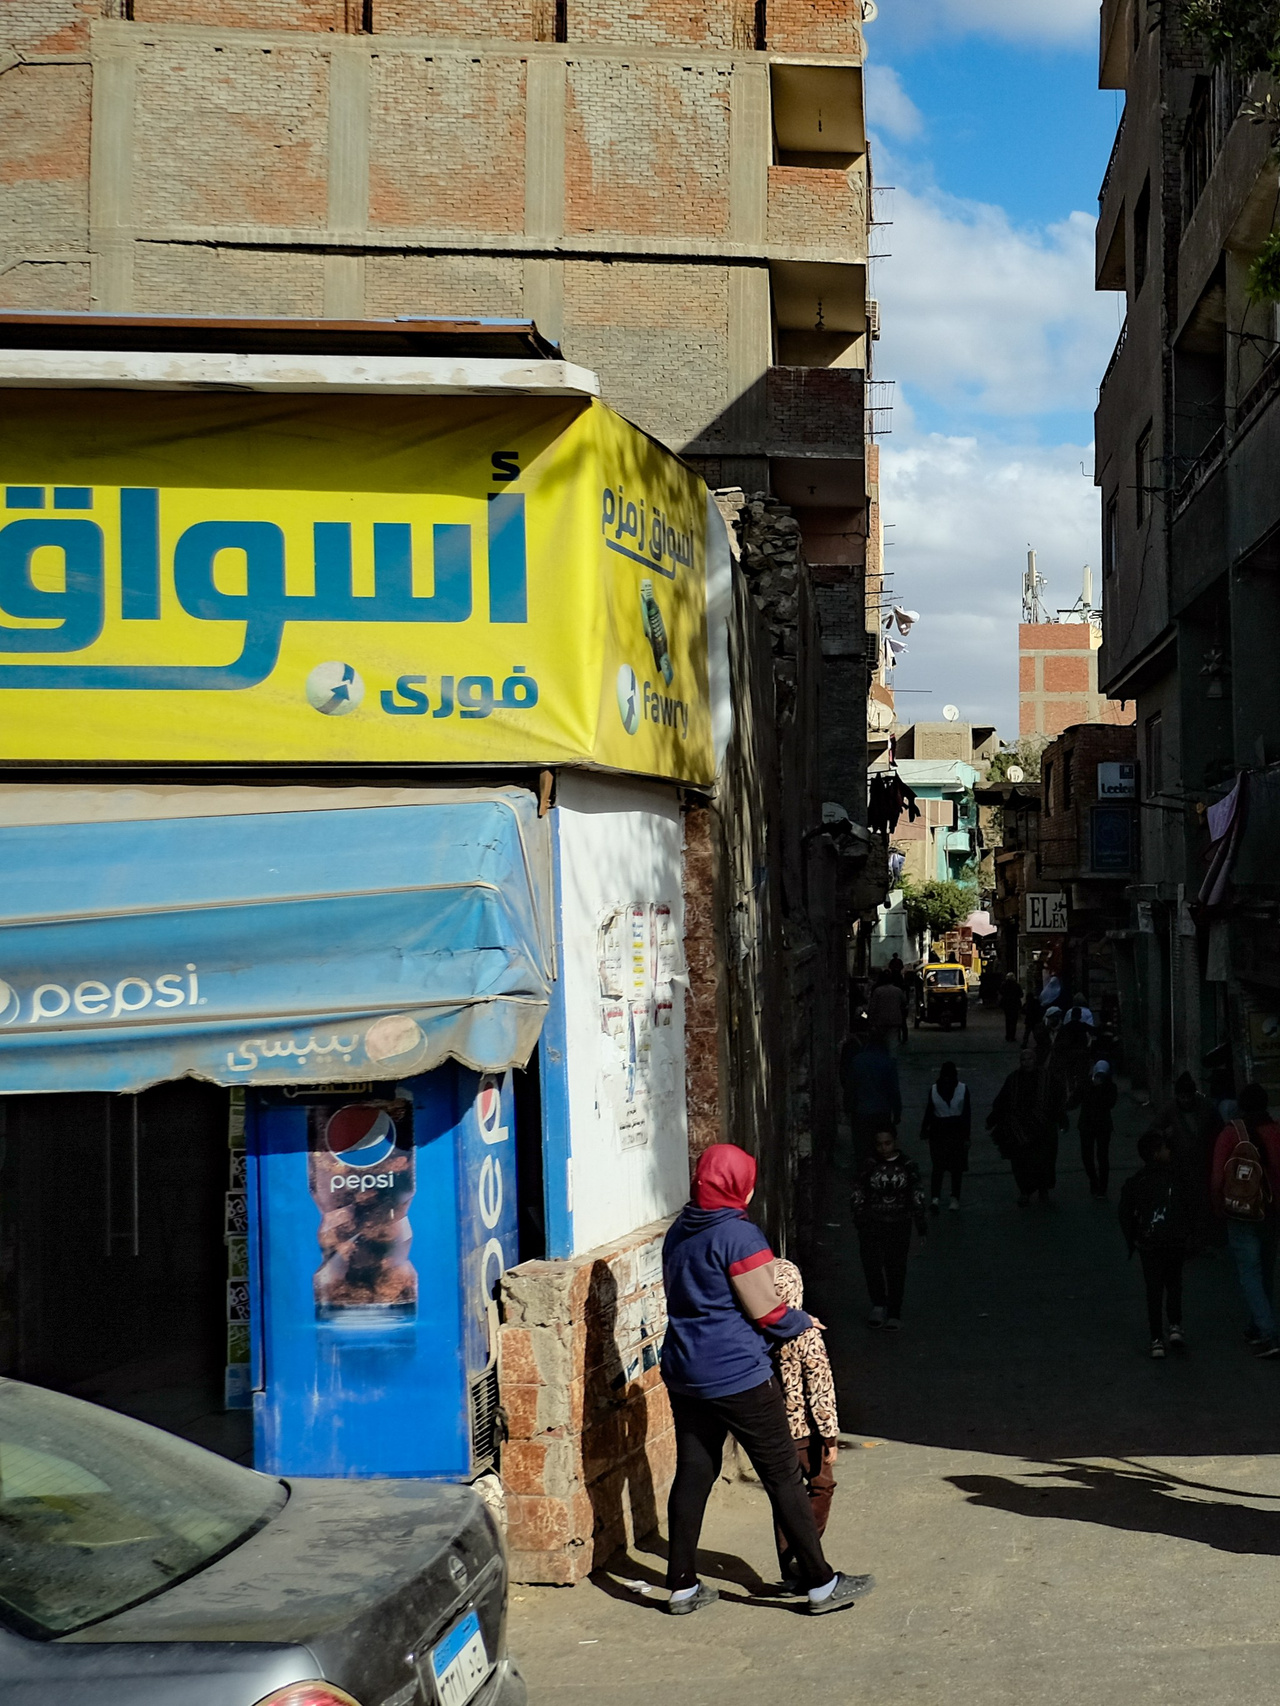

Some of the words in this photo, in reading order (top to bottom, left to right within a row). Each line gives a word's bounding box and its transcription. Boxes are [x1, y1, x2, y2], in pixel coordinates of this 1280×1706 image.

[602, 485, 645, 551] زمزم
[1030, 897, 1052, 928] EL
[29, 963, 199, 1023] pepsi
[330, 1171, 394, 1193] pepsi
